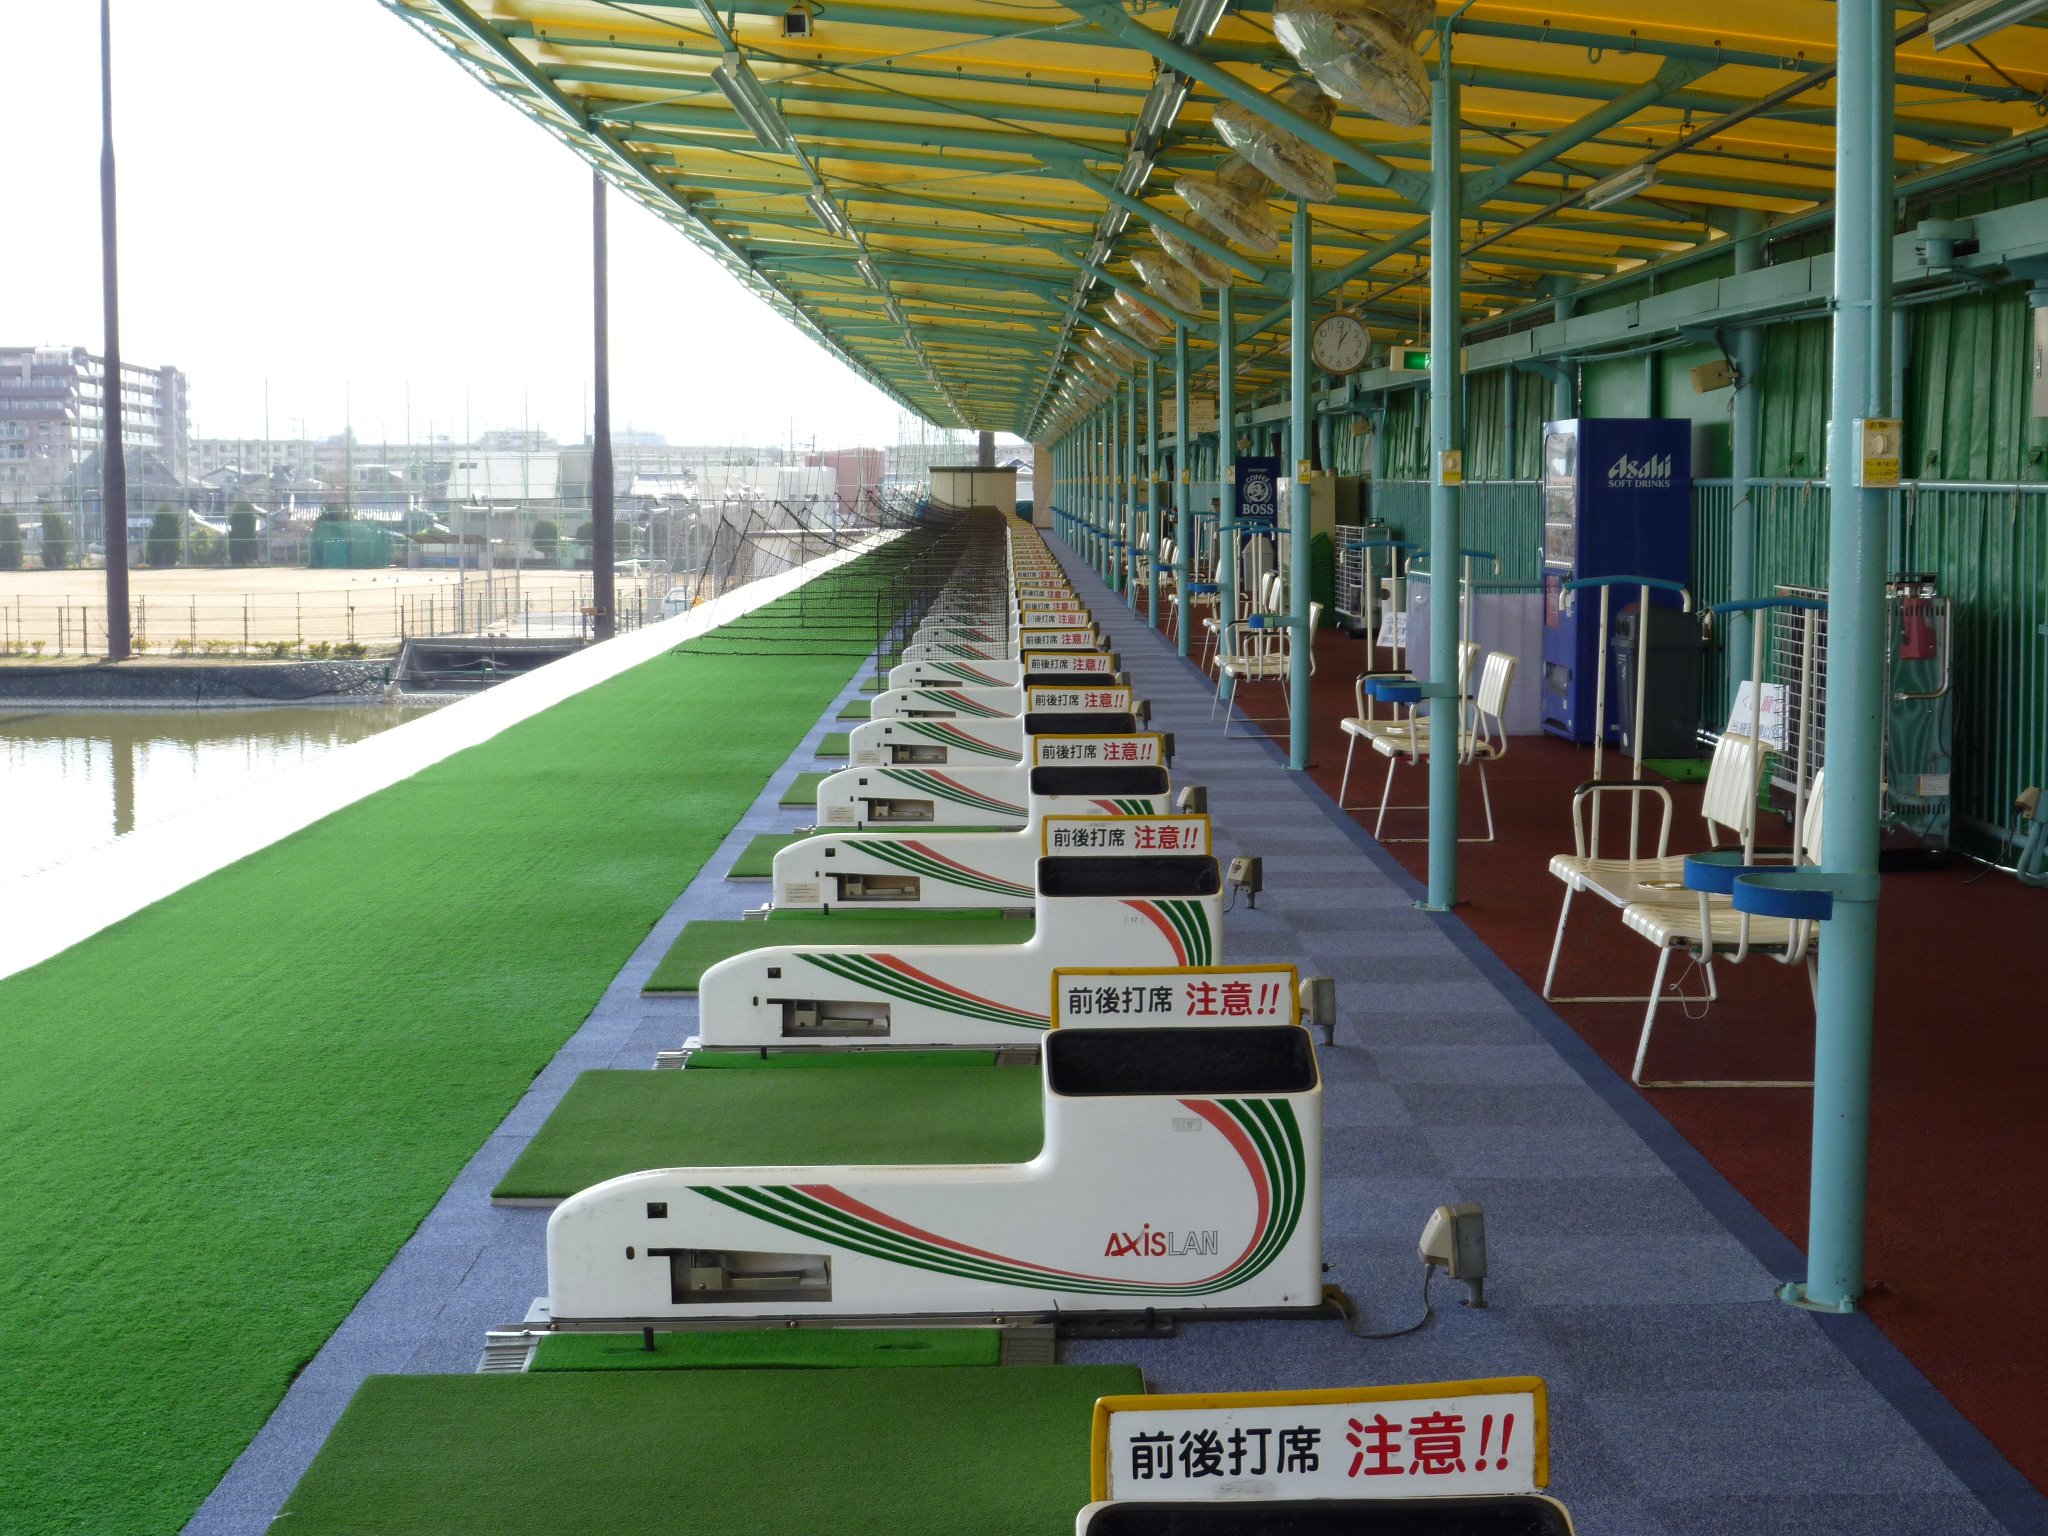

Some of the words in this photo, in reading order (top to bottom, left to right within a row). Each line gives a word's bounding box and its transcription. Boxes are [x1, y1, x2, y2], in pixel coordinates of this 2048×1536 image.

[1354, 330, 1360, 339] 2
[1317, 340, 1322, 348] 9
[1357, 340, 1362, 349] 3
[1320, 350, 1326, 358] 8
[1336, 360, 1342, 368] 6
[1346, 356, 1352, 366] 5
[1608, 453, 1671, 479] Asahi
[1246, 474, 1271, 484] COFFEE
[1608, 479, 1632, 488] SOFT
[1635, 479, 1671, 488] DRINKS
[1242, 503, 1274, 515] BOSS
[1058, 614, 1084, 625] 注意!!
[1025, 635, 1058, 645] 前後打席
[1061, 633, 1091, 645] 注意!!
[1031, 658, 1069, 669] 前後打席
[1072, 658, 1106, 671] 注意!!
[1035, 694, 1079, 706] 前後打席
[1084, 692, 1124, 708] 注意!!
[1042, 744, 1097, 760] 前後打席
[1103, 742, 1153, 761] 注意!!
[1053, 827, 1125, 848] 前後打席
[1134, 825, 1199, 850] 注意!!
[1068, 985, 1173, 1015] 前後打席
[1185, 980, 1280, 1016] 注意!!
[1129, 1424, 1321, 1481] 前後打席
[1345, 1410, 1515, 1479] 注意!!
